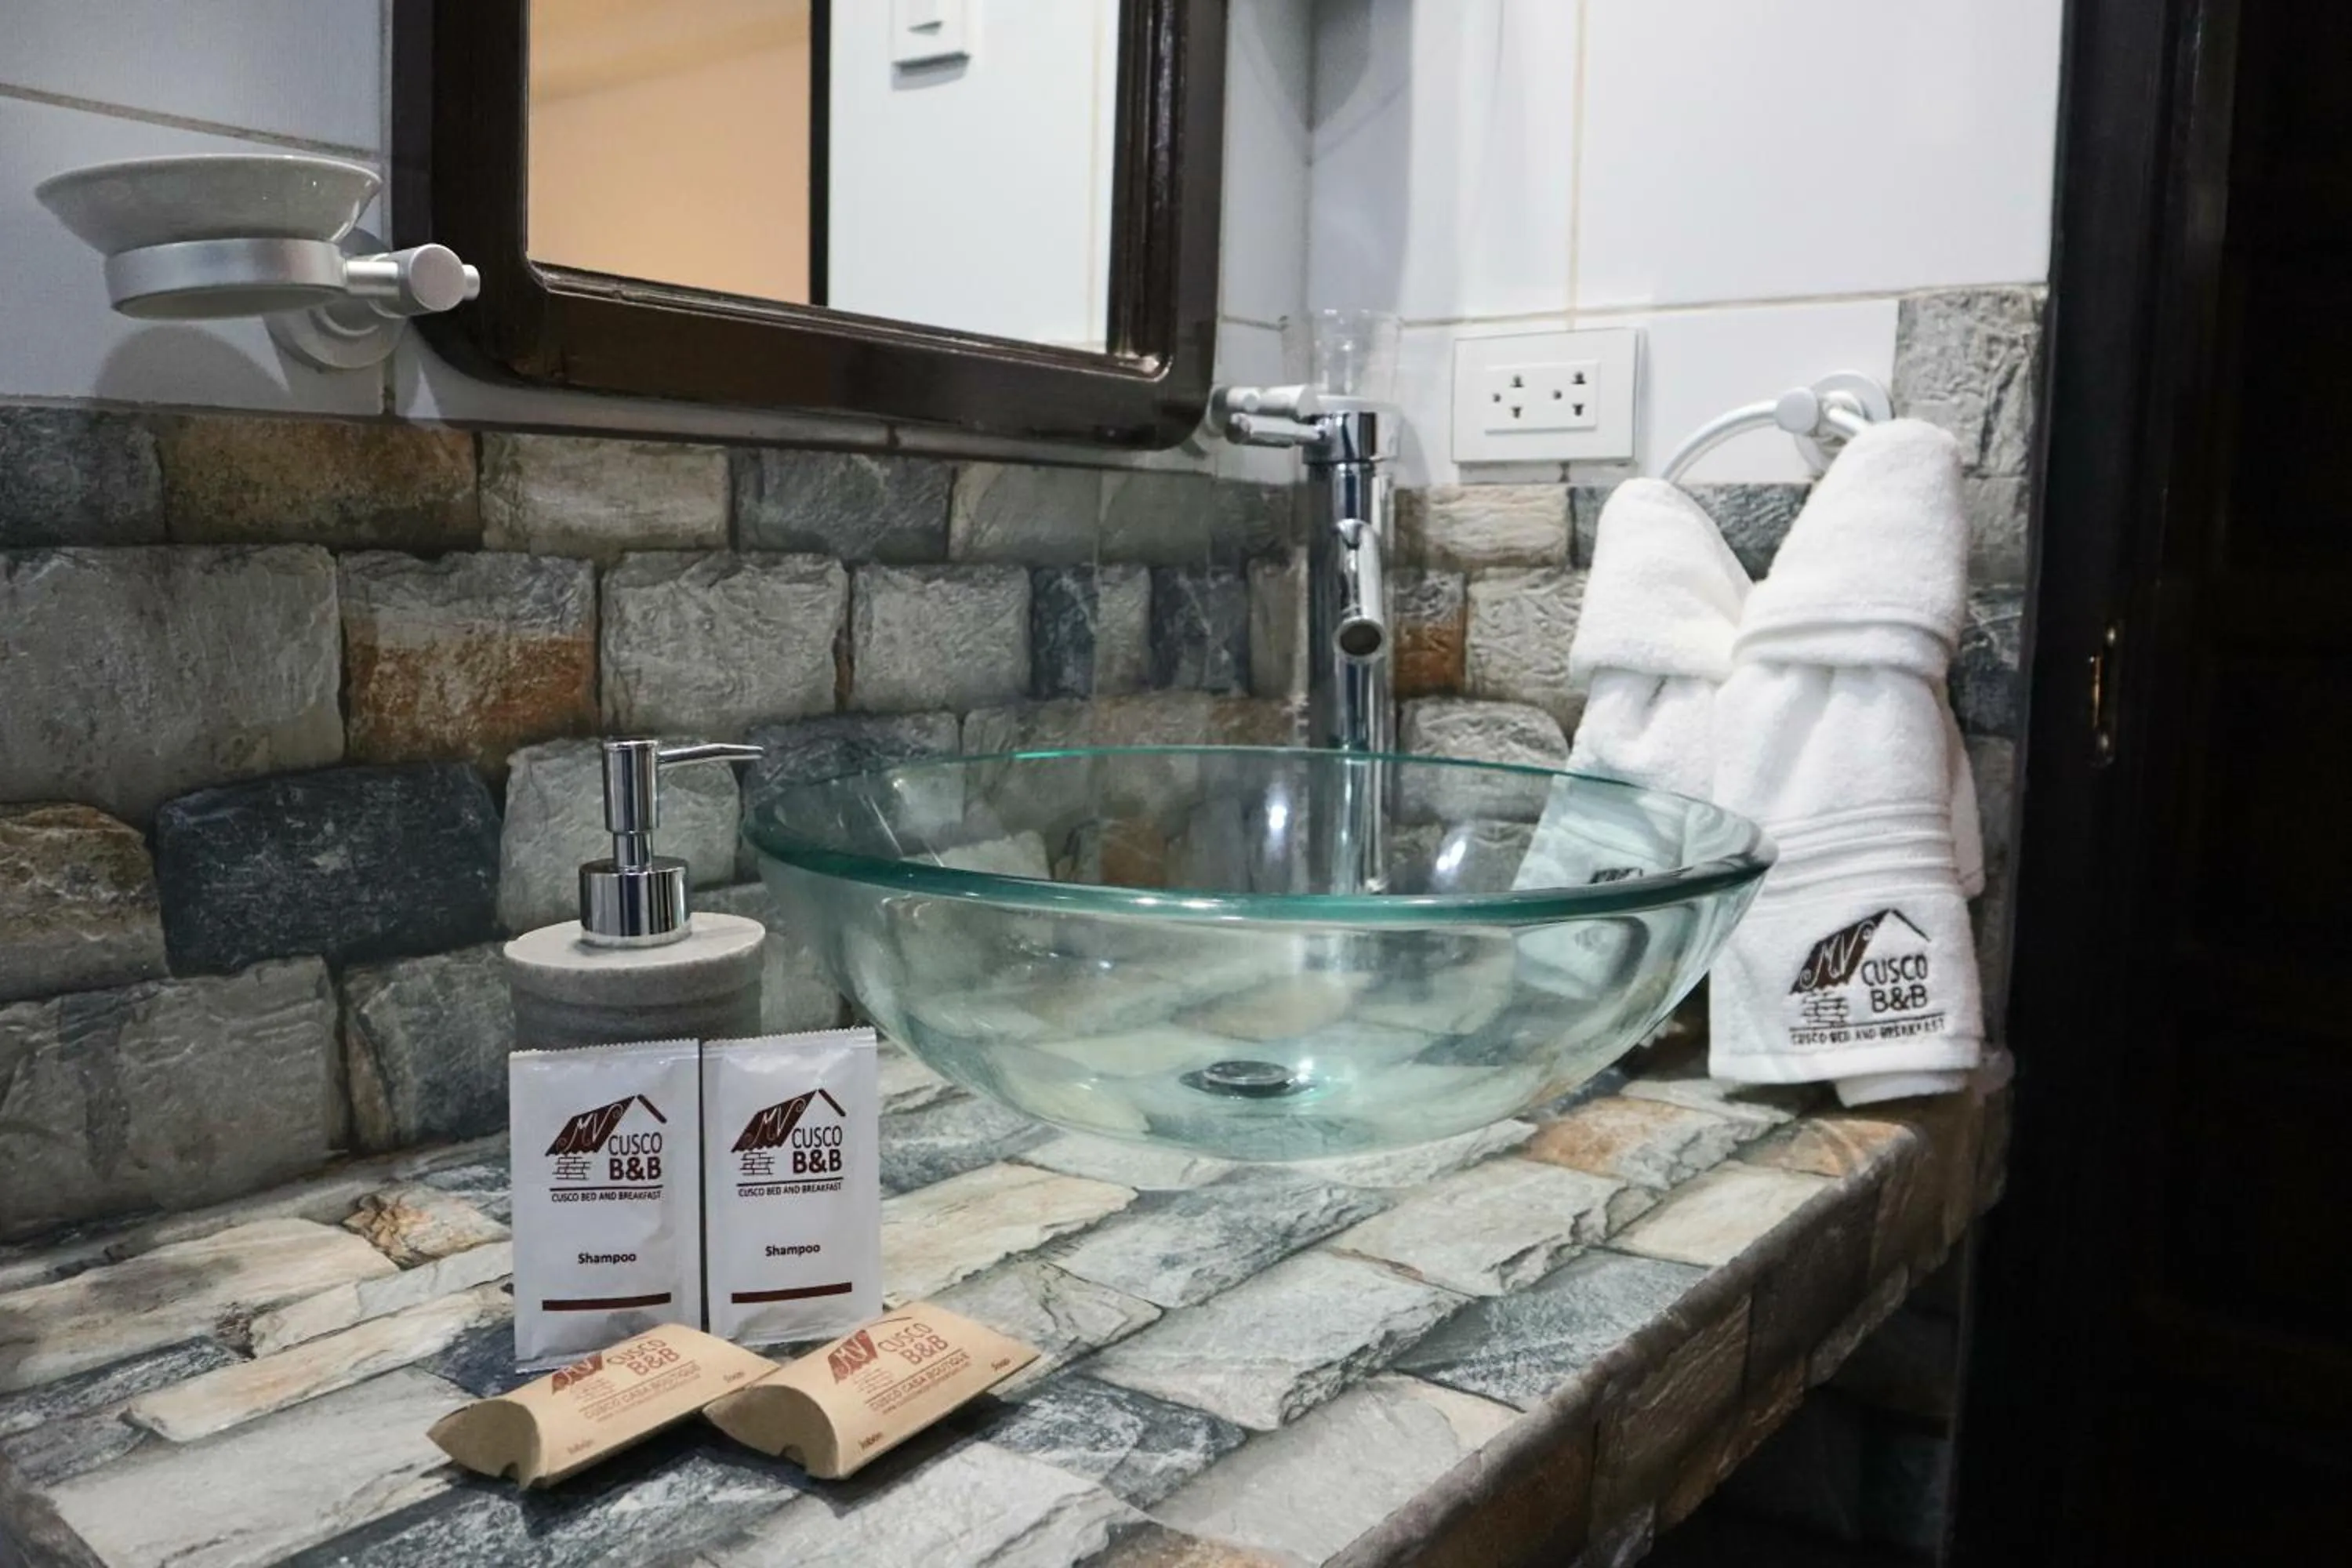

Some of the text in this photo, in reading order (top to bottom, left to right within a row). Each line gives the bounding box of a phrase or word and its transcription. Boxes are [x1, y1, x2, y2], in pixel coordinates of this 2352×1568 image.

[1860, 953, 1929, 987] CUSCO
[1870, 984, 1929, 1014] B&B
[608, 1131, 662, 1156] CUSCO
[791, 1125, 843, 1149] CUSCO
[609, 1156, 662, 1181] B&B
[792, 1149, 843, 1174] B&B
[551, 1189, 662, 1203] CUSCO BED AND BREAKFAST
[738, 1181, 842, 1197] CUSCO BED AND BREAKFAST
[577, 1251, 637, 1265] Shampoo
[765, 1243, 821, 1258] Shampoo
[877, 1323, 933, 1353] CUSCO
[900, 1334, 949, 1366] B&B
[606, 1339, 666, 1365] CUSCO
[626, 1348, 681, 1376] B&B
